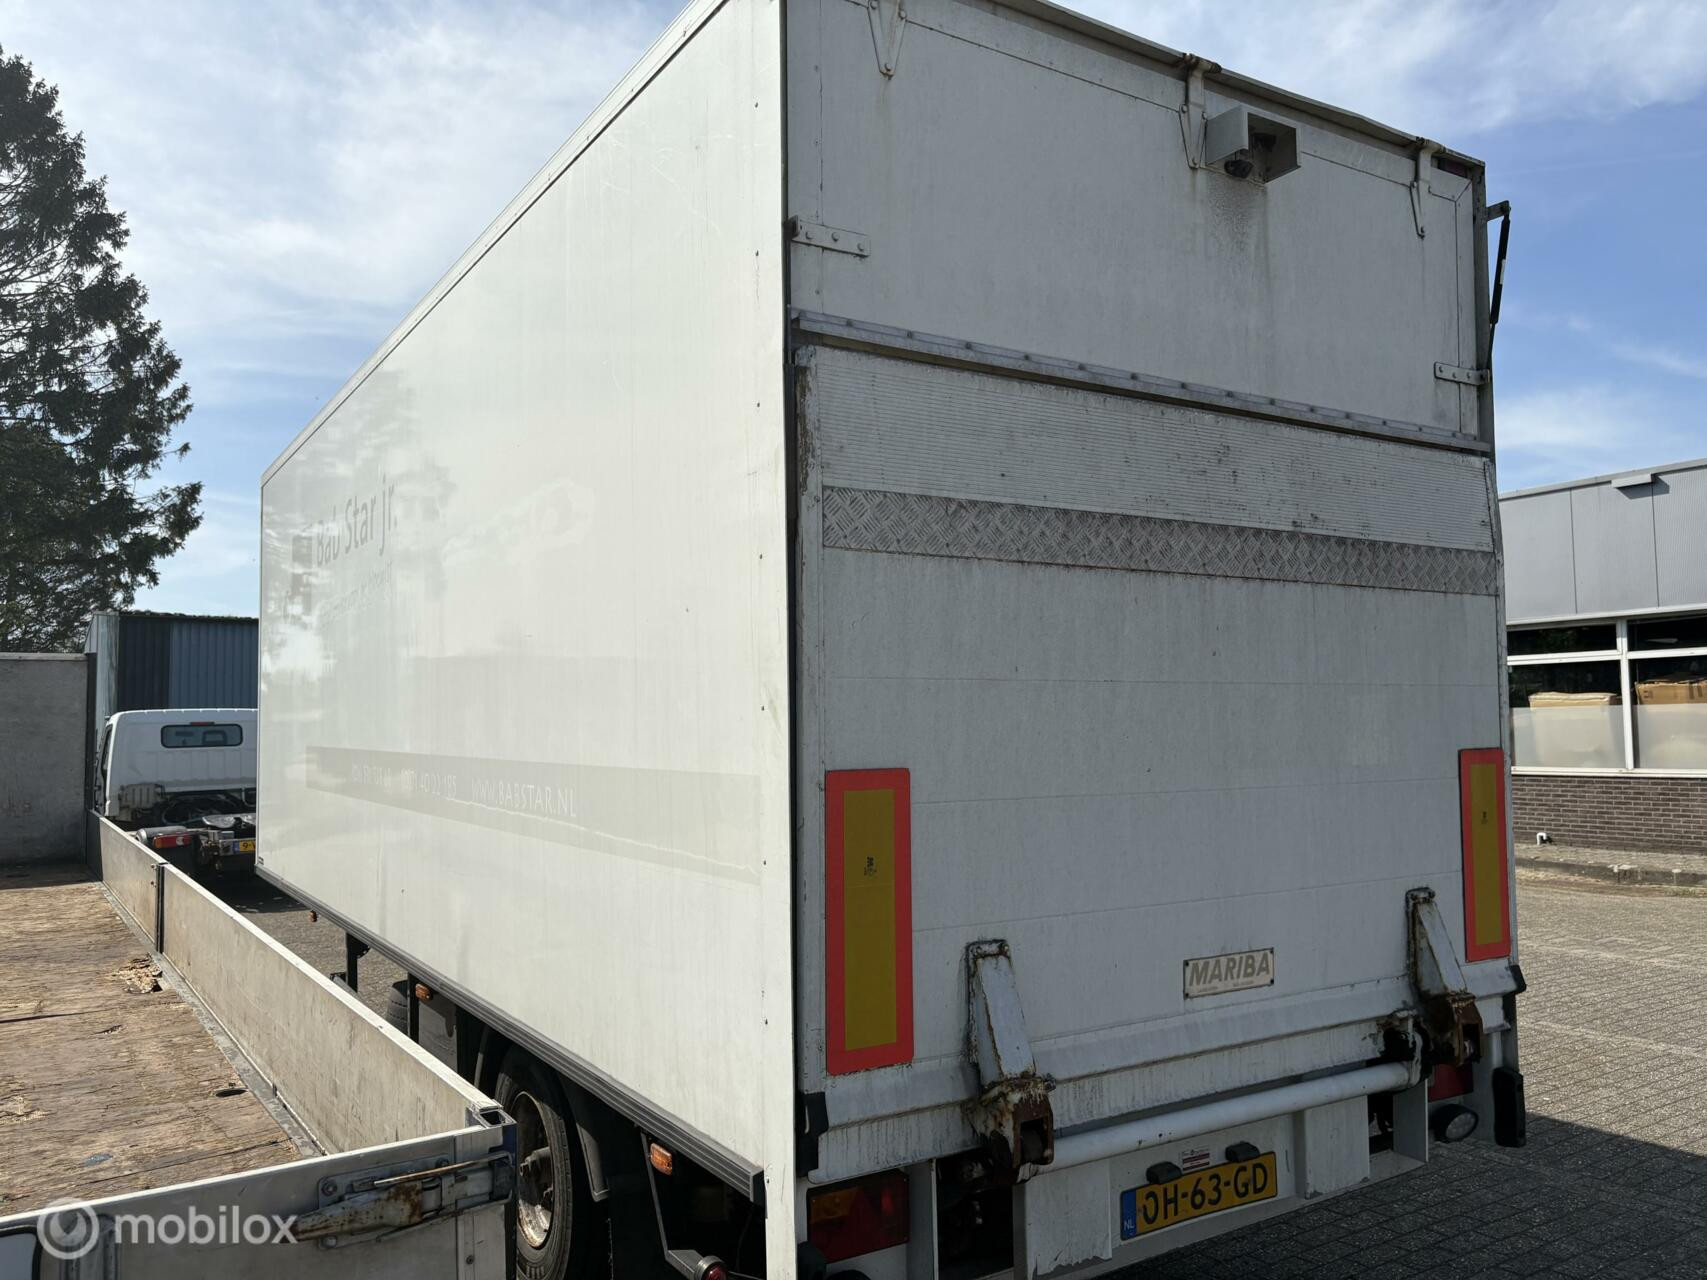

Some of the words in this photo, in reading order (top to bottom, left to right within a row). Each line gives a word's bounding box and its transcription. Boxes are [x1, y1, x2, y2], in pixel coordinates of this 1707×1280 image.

[344, 495, 377, 555] Star
[379, 472, 398, 557] jr.
[1189, 951, 1270, 987] MARIBA
[1123, 1218, 1135, 1231] NL
[1142, 1162, 1268, 1225] OH-63-GD
